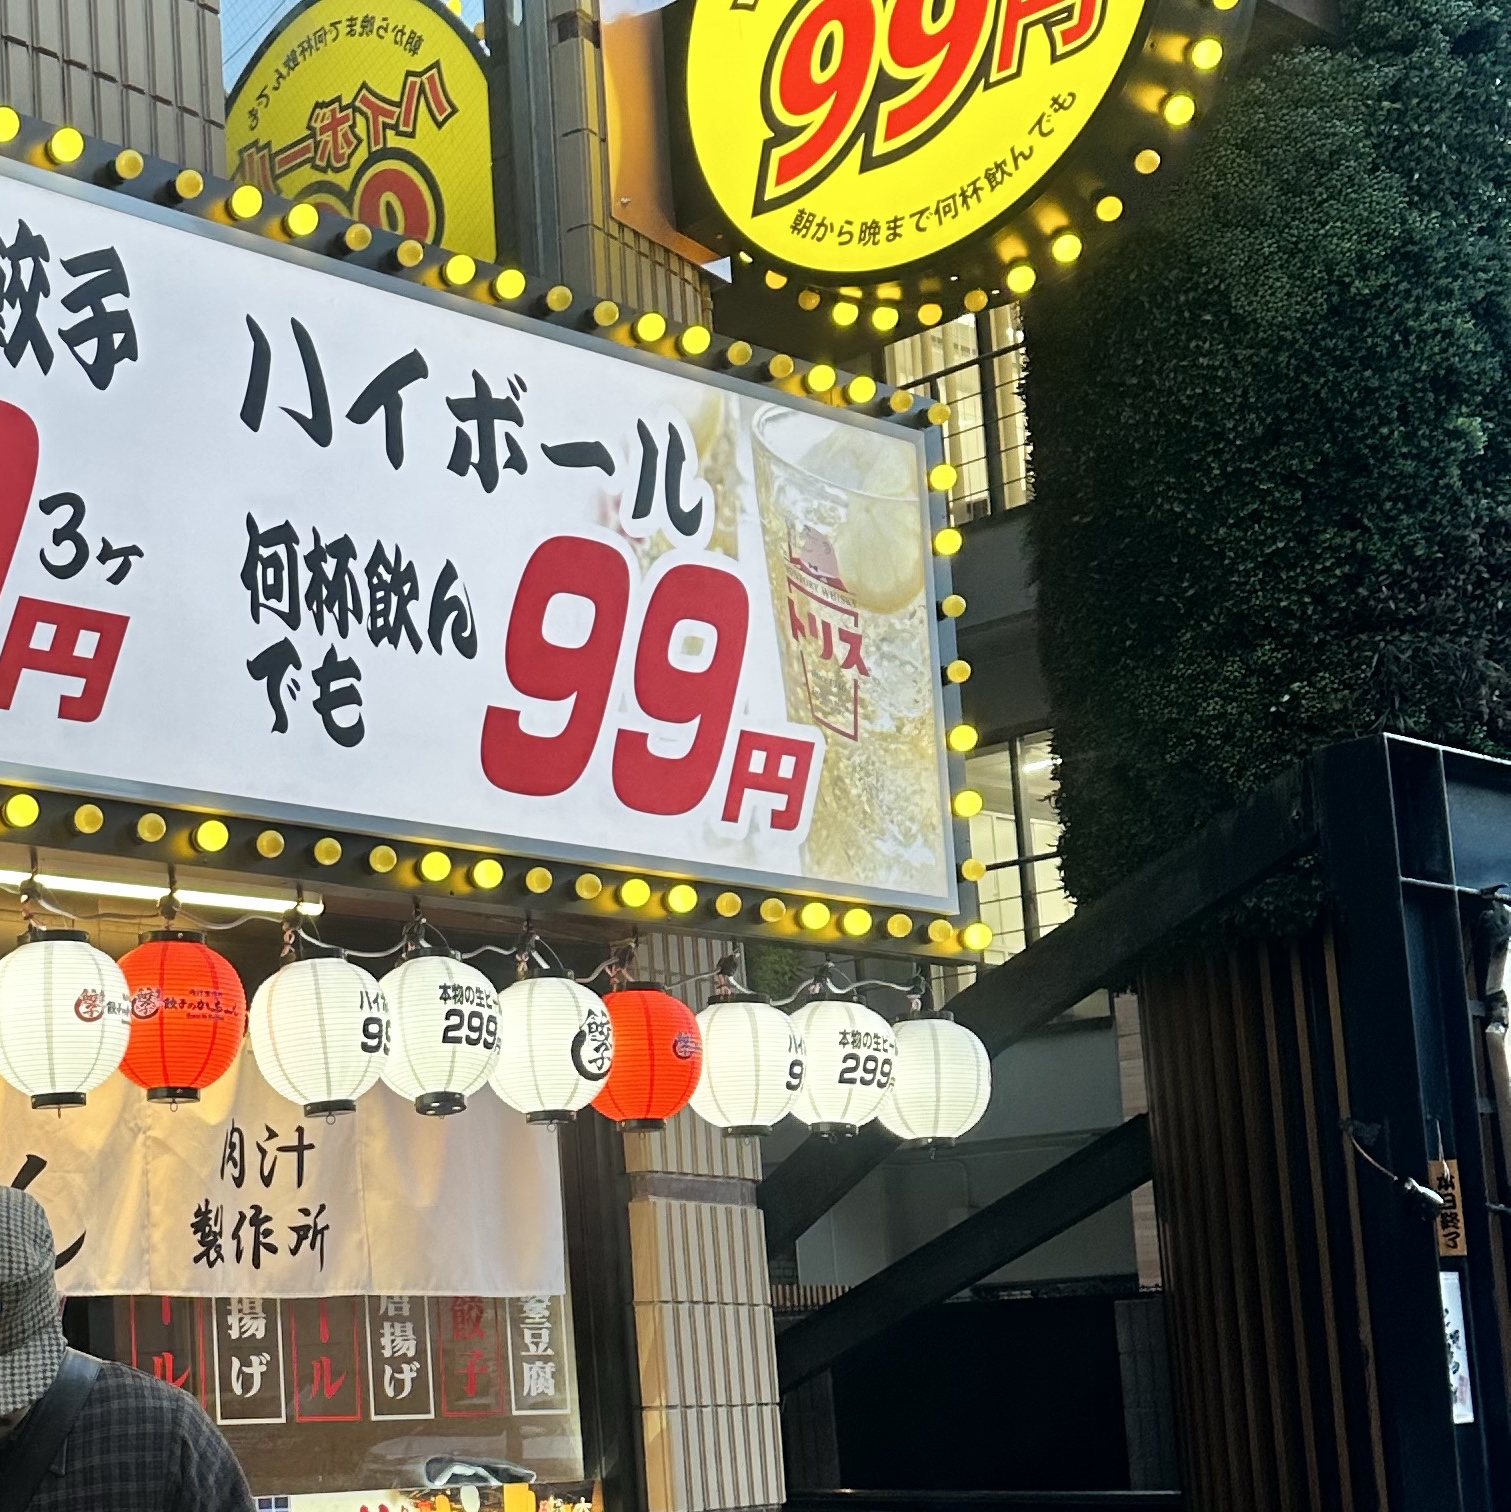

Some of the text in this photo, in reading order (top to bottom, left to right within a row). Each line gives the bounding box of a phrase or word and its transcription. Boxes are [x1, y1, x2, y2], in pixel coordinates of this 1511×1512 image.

[790, 91, 1077, 247] 朝から晩まで何杯飲んでも
[241, 313, 705, 536] ハイボール
[239, 513, 478, 660] 何杯飲ん
[787, 595, 870, 677] トリス
[248, 637, 366, 748] でも
[189, 1199, 331, 1273] 製作所
